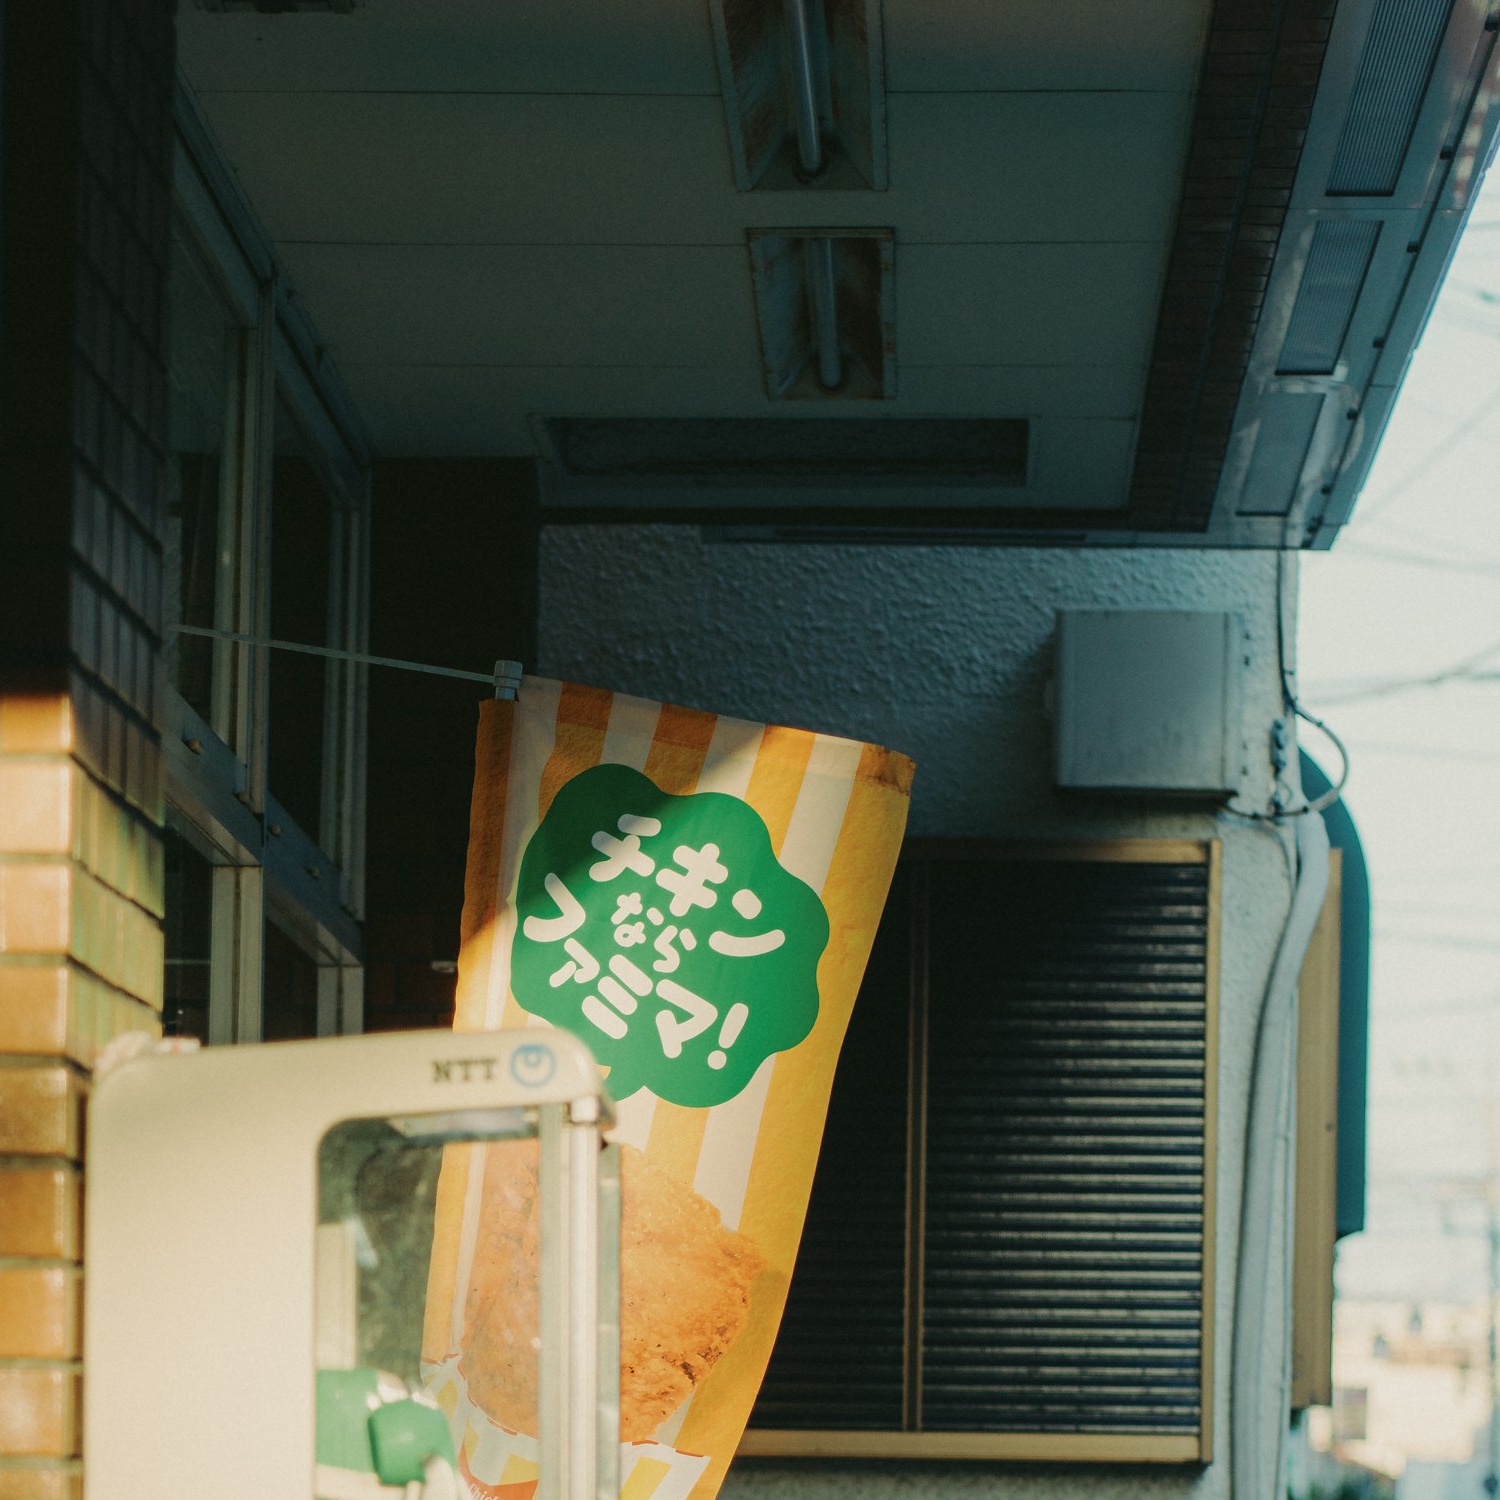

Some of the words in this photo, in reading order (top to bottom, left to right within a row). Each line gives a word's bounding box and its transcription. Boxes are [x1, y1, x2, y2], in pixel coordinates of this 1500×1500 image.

[589, 813, 786, 957] チキン
[611, 892, 698, 973] なら
[432, 1057, 498, 1083] NTT
